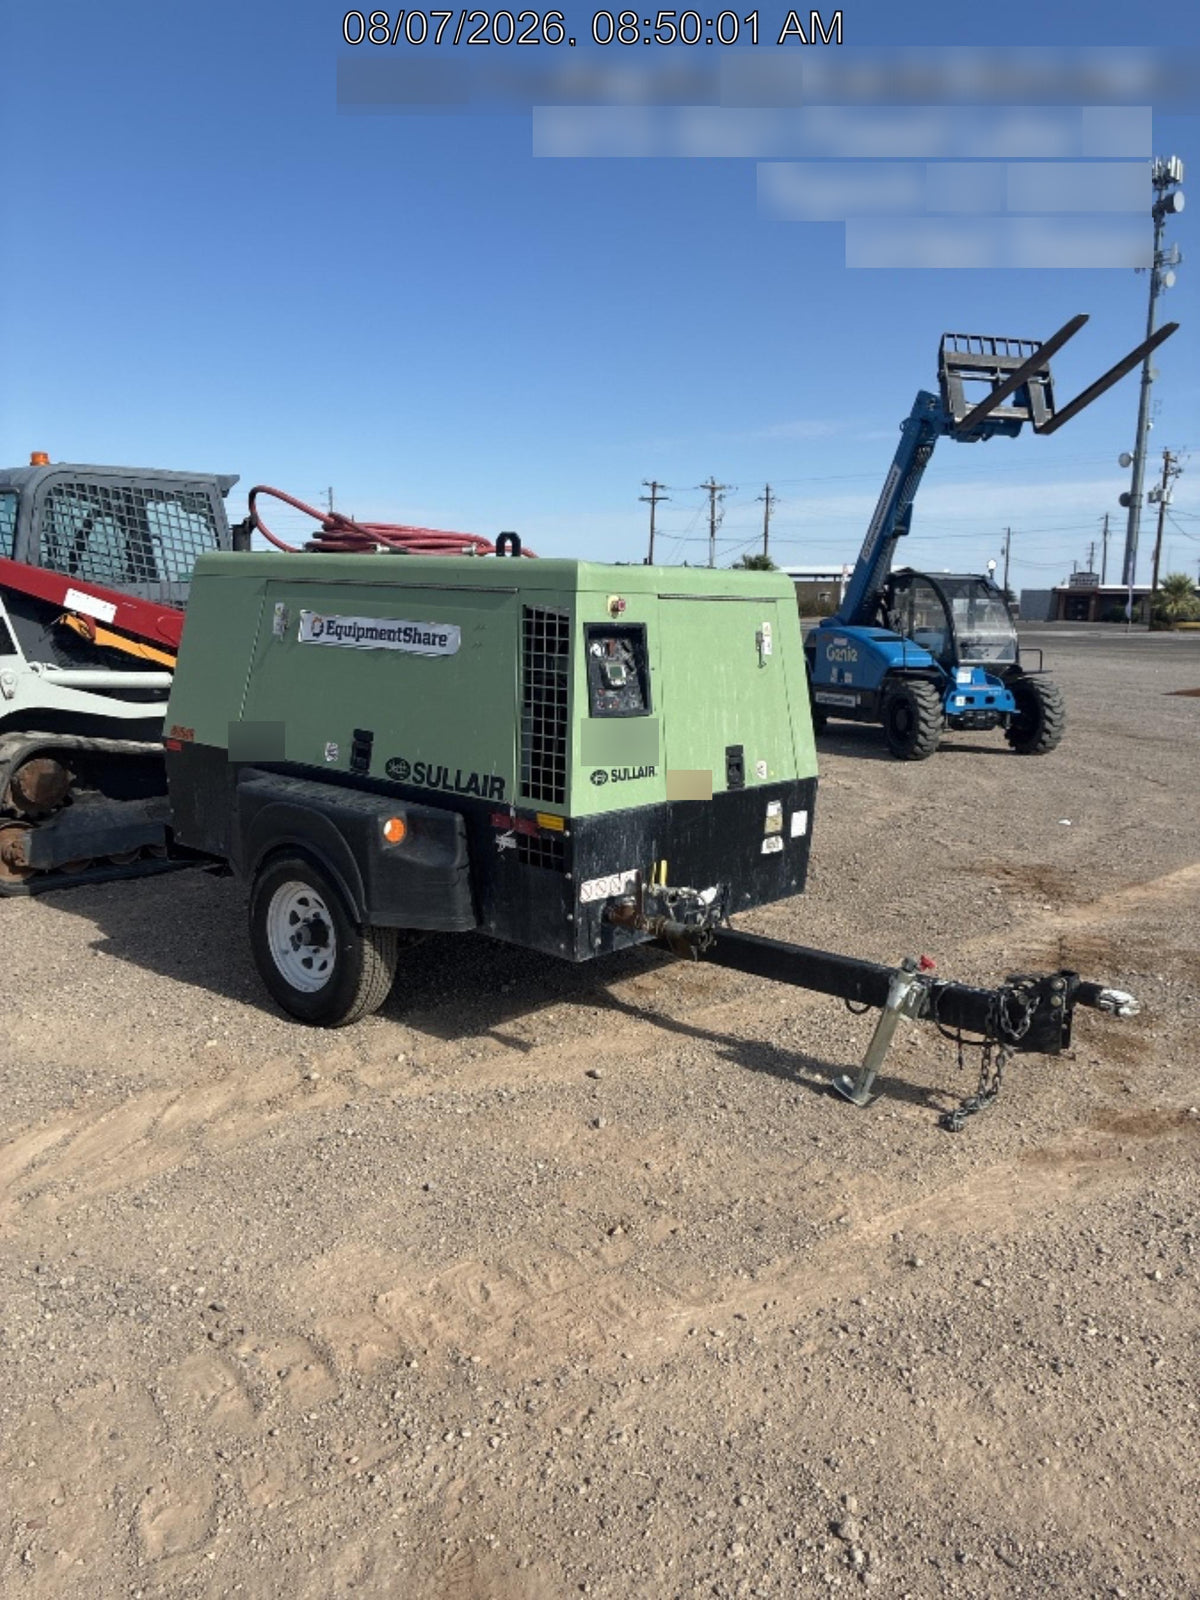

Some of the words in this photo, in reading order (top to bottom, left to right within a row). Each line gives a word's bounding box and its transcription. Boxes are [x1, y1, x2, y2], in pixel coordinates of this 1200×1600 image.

[325, 619, 448, 648] EquipmentShare
[412, 761, 506, 801] SULLAIR
[611, 765, 655, 783] SULLAIR
